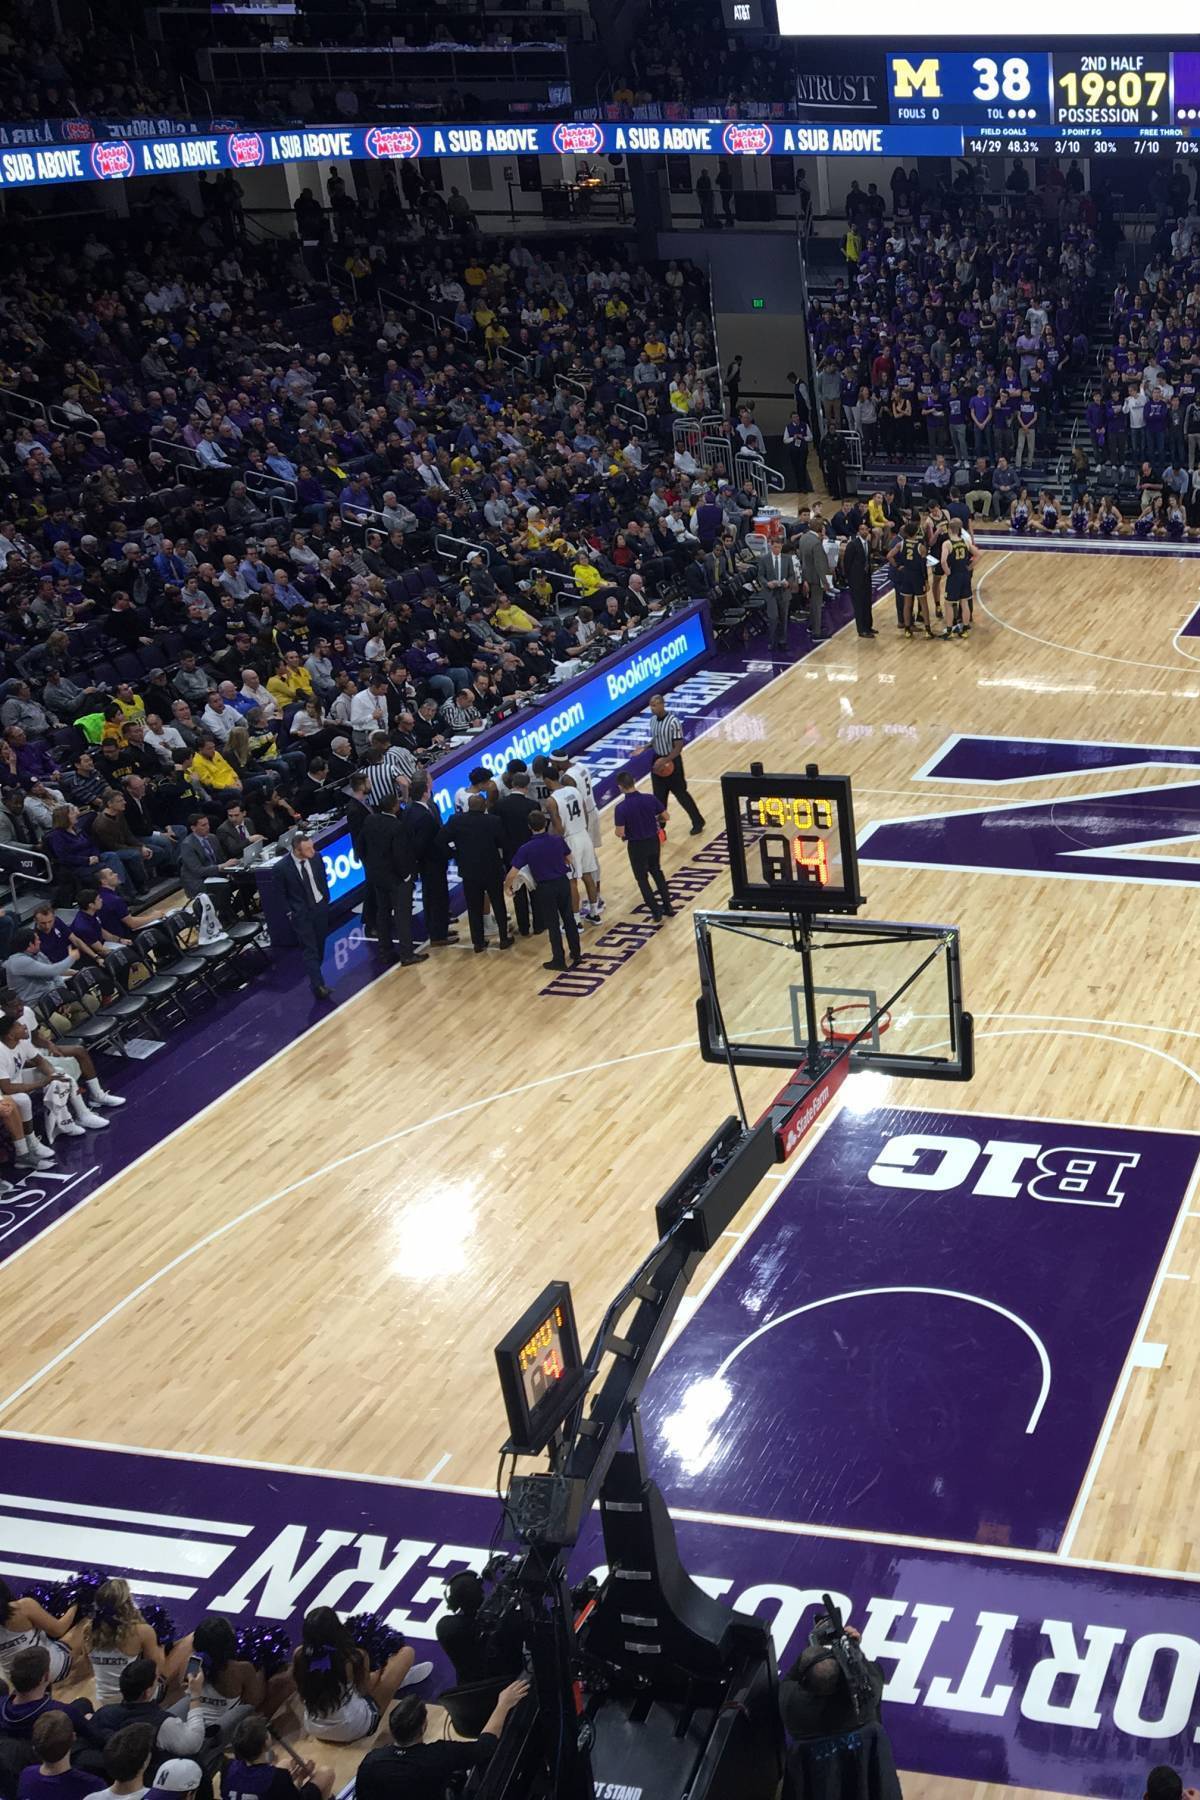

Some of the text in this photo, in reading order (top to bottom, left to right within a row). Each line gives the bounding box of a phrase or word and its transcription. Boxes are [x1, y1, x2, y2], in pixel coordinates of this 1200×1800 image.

[733, 4, 750, 20] AT&T
[1080, 56, 1144, 71] 2ND HALF
[892, 58, 943, 98] M
[972, 57, 1031, 101] 38
[1059, 72, 1166, 106] 19:07
[898, 108, 940, 119] FOULS 0
[987, 108, 1004, 119] TOL
[1059, 108, 1139, 122] POSSESSION
[271, 133, 352, 159] A SUB ABOVE
[434, 129, 538, 152] A SUB ABOVE
[616, 128, 712, 149] A SUB ABOVE
[784, 129, 882, 151] A SUB ABOVE
[970, 141, 1039, 153] 14/29 48.3%
[1055, 141, 1117, 153] 3/10 30%
[1134, 141, 1199, 153] 7/10 70%
[3, 150, 83, 182] SUB ABOVE
[143, 141, 220, 169] A SUB ABOVE
[606, 634, 689, 701] Booking.com
[566, 799, 581, 822] 14
[759, 797, 832, 829] 19:07
[793, 837, 828, 885] 4
